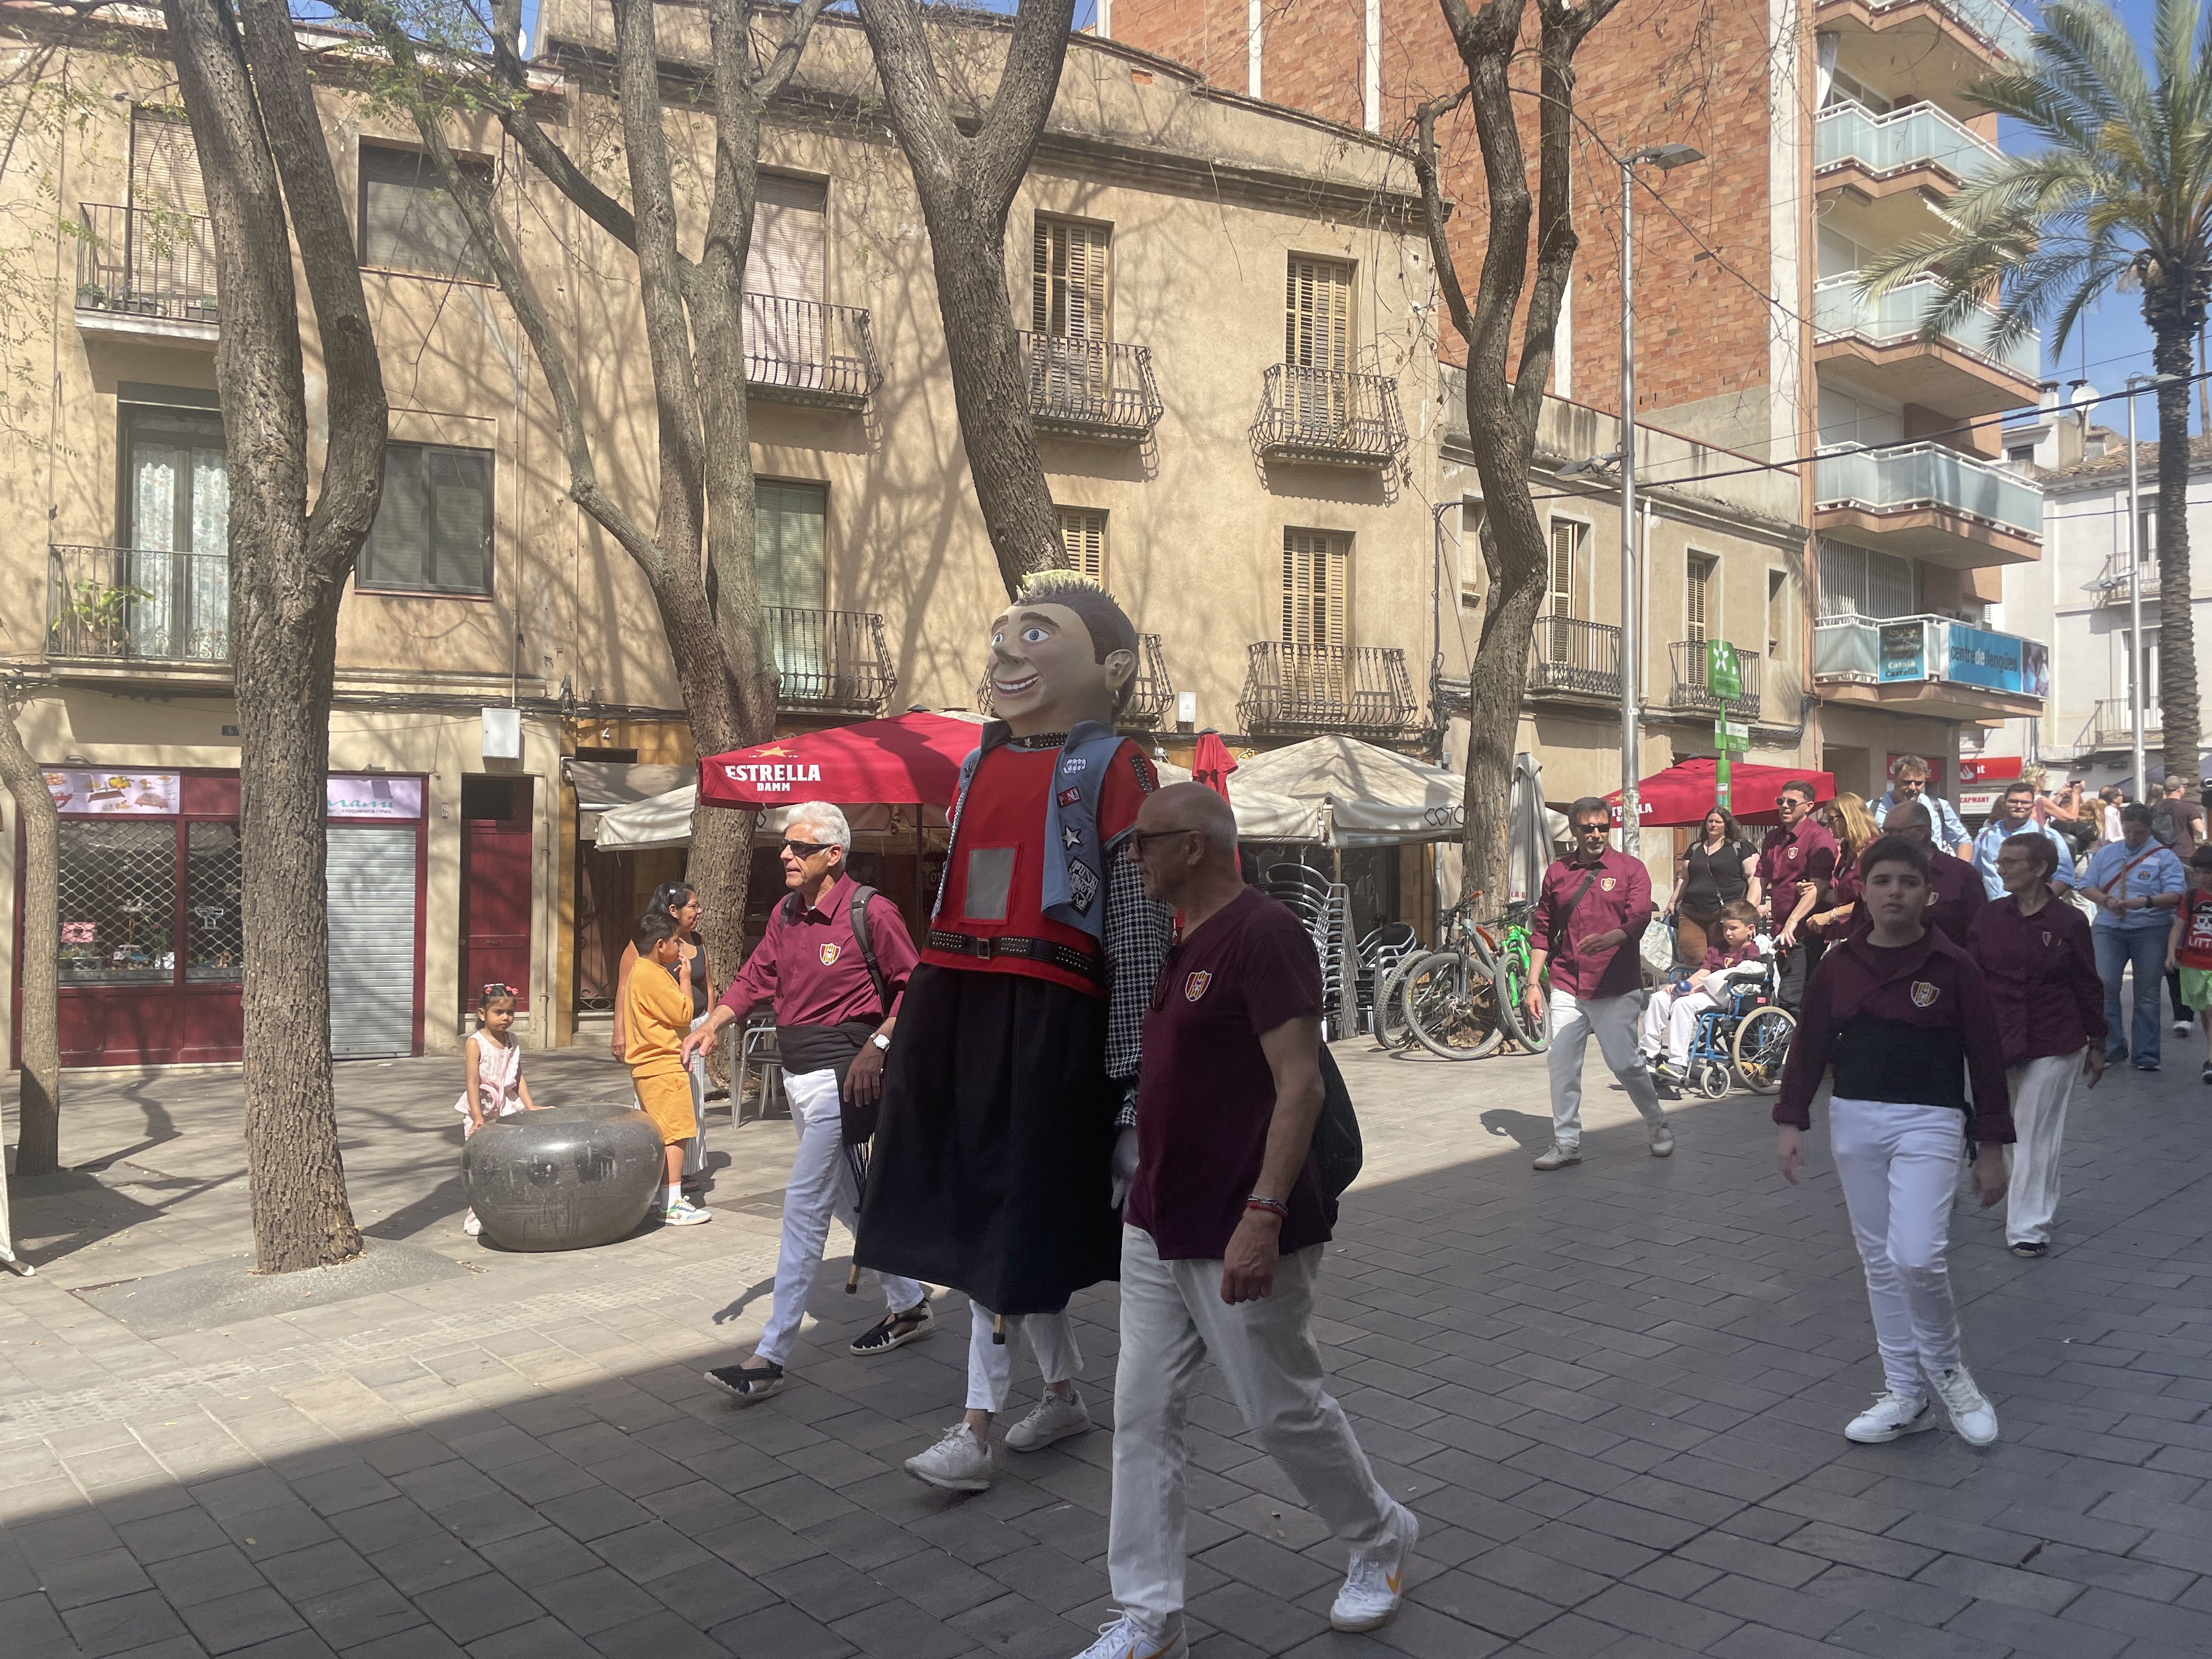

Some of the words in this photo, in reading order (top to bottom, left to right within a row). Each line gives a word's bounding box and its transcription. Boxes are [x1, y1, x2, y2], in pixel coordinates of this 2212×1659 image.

[725, 764, 821, 781] ESTRELLA
[757, 782, 791, 791] DAMM
[2188, 935, 2212, 948] LITT
